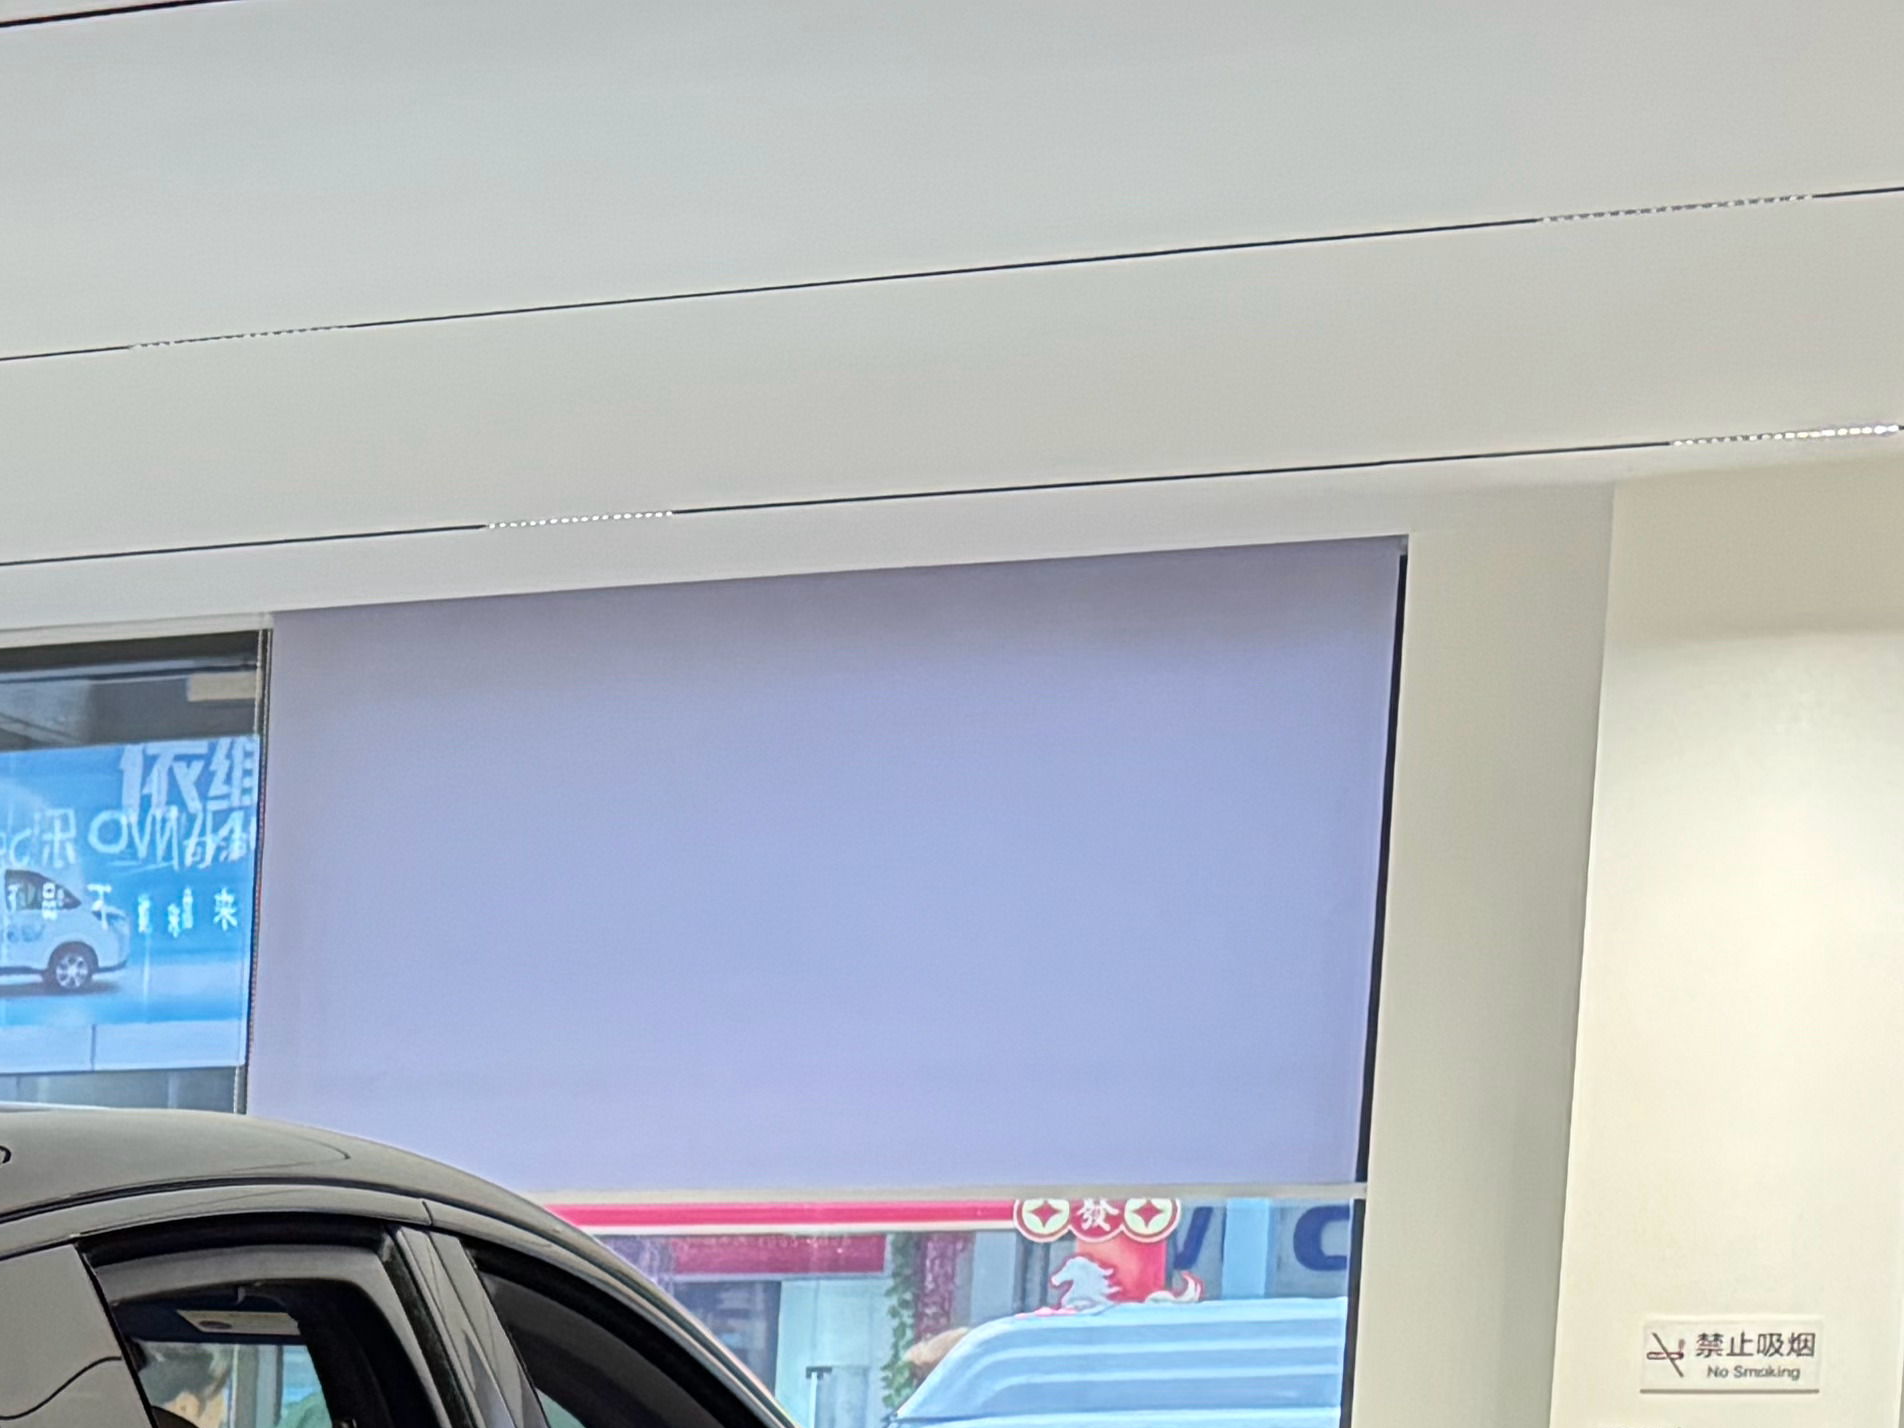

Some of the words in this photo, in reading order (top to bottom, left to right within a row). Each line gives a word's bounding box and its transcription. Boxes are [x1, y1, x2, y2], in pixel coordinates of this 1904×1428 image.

[1076, 1198, 1120, 1232] 發
[1695, 1331, 1816, 1359] 禁止吸烟
[1706, 1365, 1729, 1379] No
[1733, 1364, 1801, 1382] Smoking
